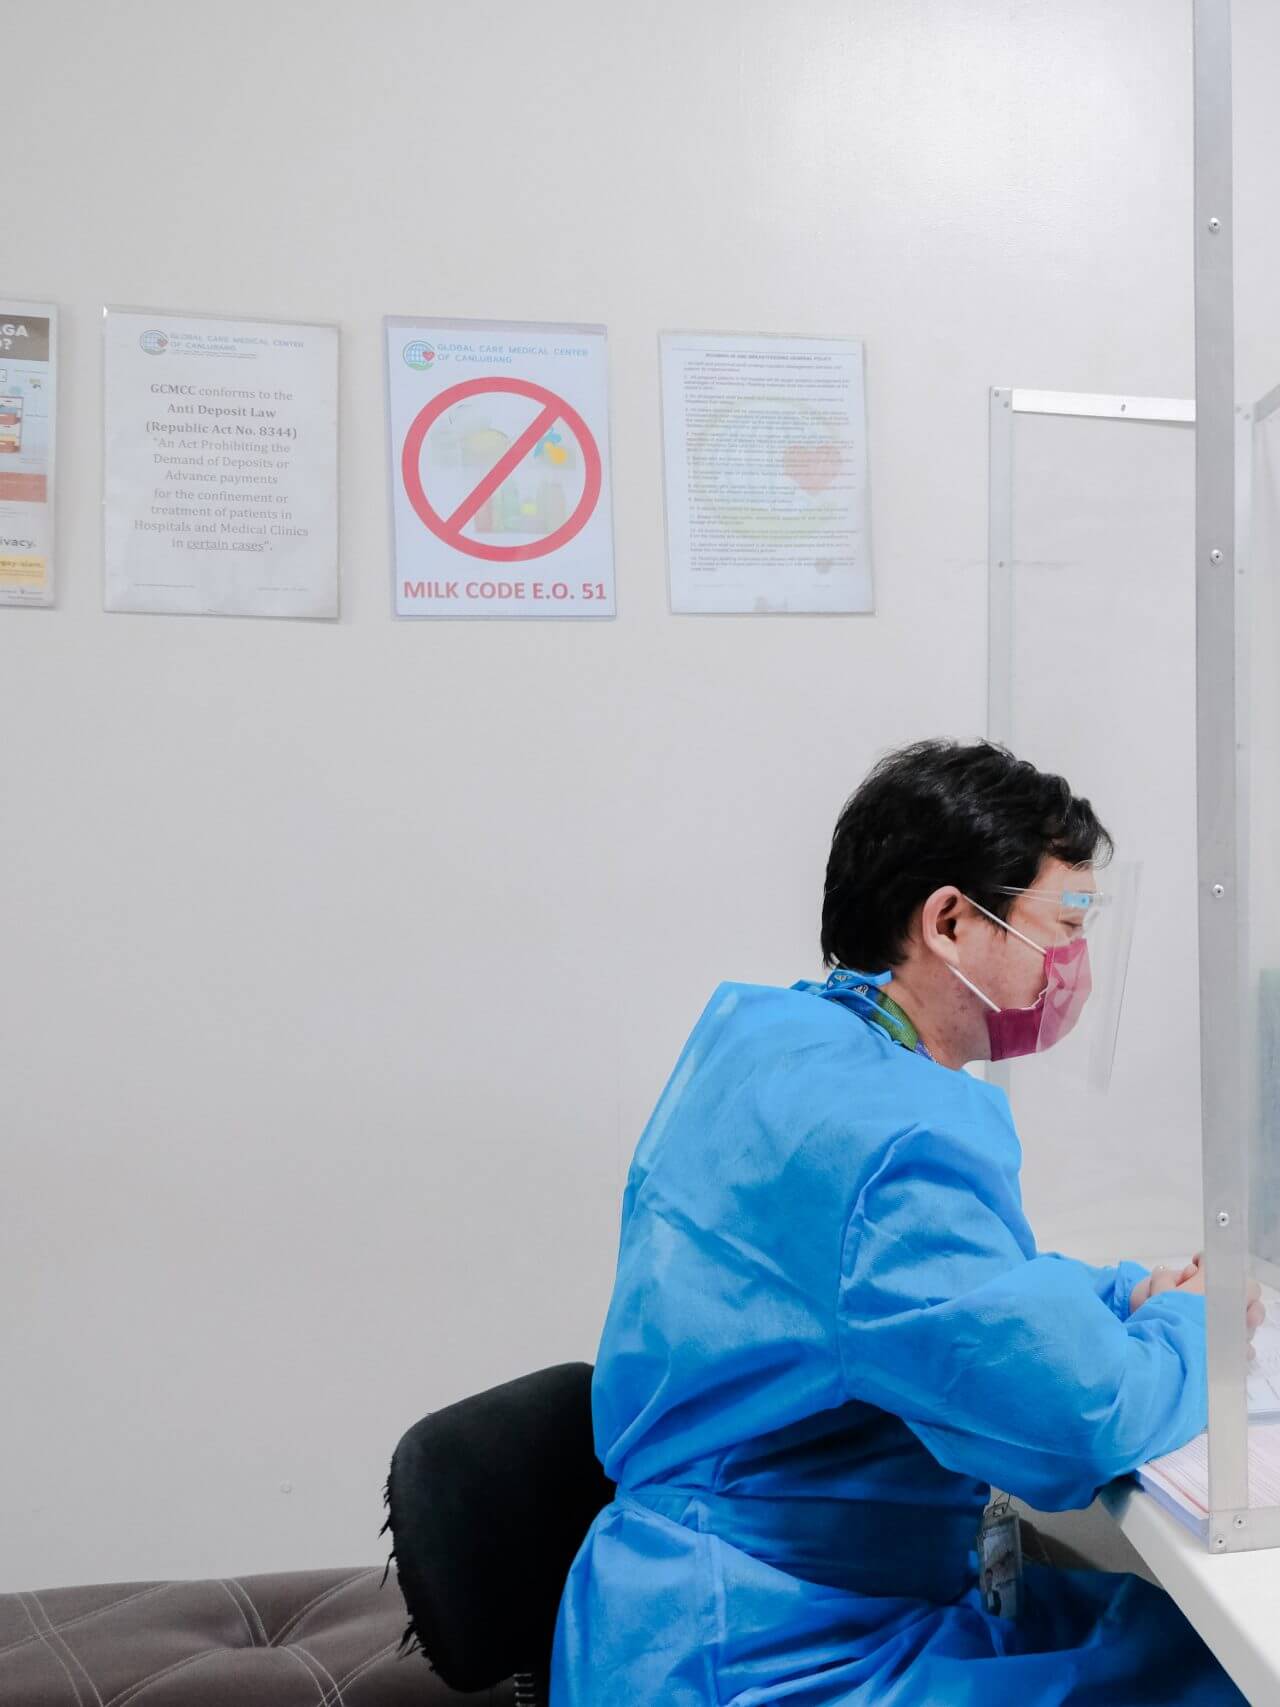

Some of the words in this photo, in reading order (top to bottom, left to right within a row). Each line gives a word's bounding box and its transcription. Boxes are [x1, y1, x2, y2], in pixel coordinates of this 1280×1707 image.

[0, 324, 28, 337] GA
[437, 343, 474, 353] GLOBAL
[479, 344, 504, 354] CARE
[508, 345, 547, 356] MEDICAL
[437, 353, 449, 361] OF
[150, 383, 195, 396] GCMCC
[199, 385, 256, 400] conforms
[258, 388, 271, 400] to
[274, 388, 294, 401] the
[167, 403, 194, 415] Anti
[198, 404, 247, 418] Deposit
[250, 407, 278, 419] Law
[145, 420, 210, 436] (Republic
[211, 424, 233, 435] Act
[235, 425, 256, 437] No.
[259, 425, 298, 440] 8344)
[178, 438, 197, 449] Act
[201, 439, 269, 454] Prohibiting
[271, 443, 291, 453] the
[153, 453, 204, 465] Demand
[207, 455, 222, 466] of
[222, 456, 274, 470] Deposits
[276, 461, 290, 469] or
[165, 470, 217, 482] Advance
[220, 474, 279, 486] payments
[153, 488, 171, 499] for
[175, 489, 194, 500] the
[197, 490, 273, 503] confinement
[275, 494, 289, 504] or
[151, 505, 211, 517] treatment
[214, 506, 227, 517] of
[229, 508, 278, 521] patients
[281, 509, 293, 520] in
[134, 519, 192, 534] Hospitals
[194, 521, 217, 533] and
[220, 522, 267, 535] Medical
[270, 523, 309, 537] Clinics
[172, 538, 184, 548] in
[186, 538, 229, 551] certain
[403, 581, 459, 599] MILK
[465, 582, 525, 600] CODE
[533, 583, 575, 600] E.O.
[582, 583, 607, 600] 51
